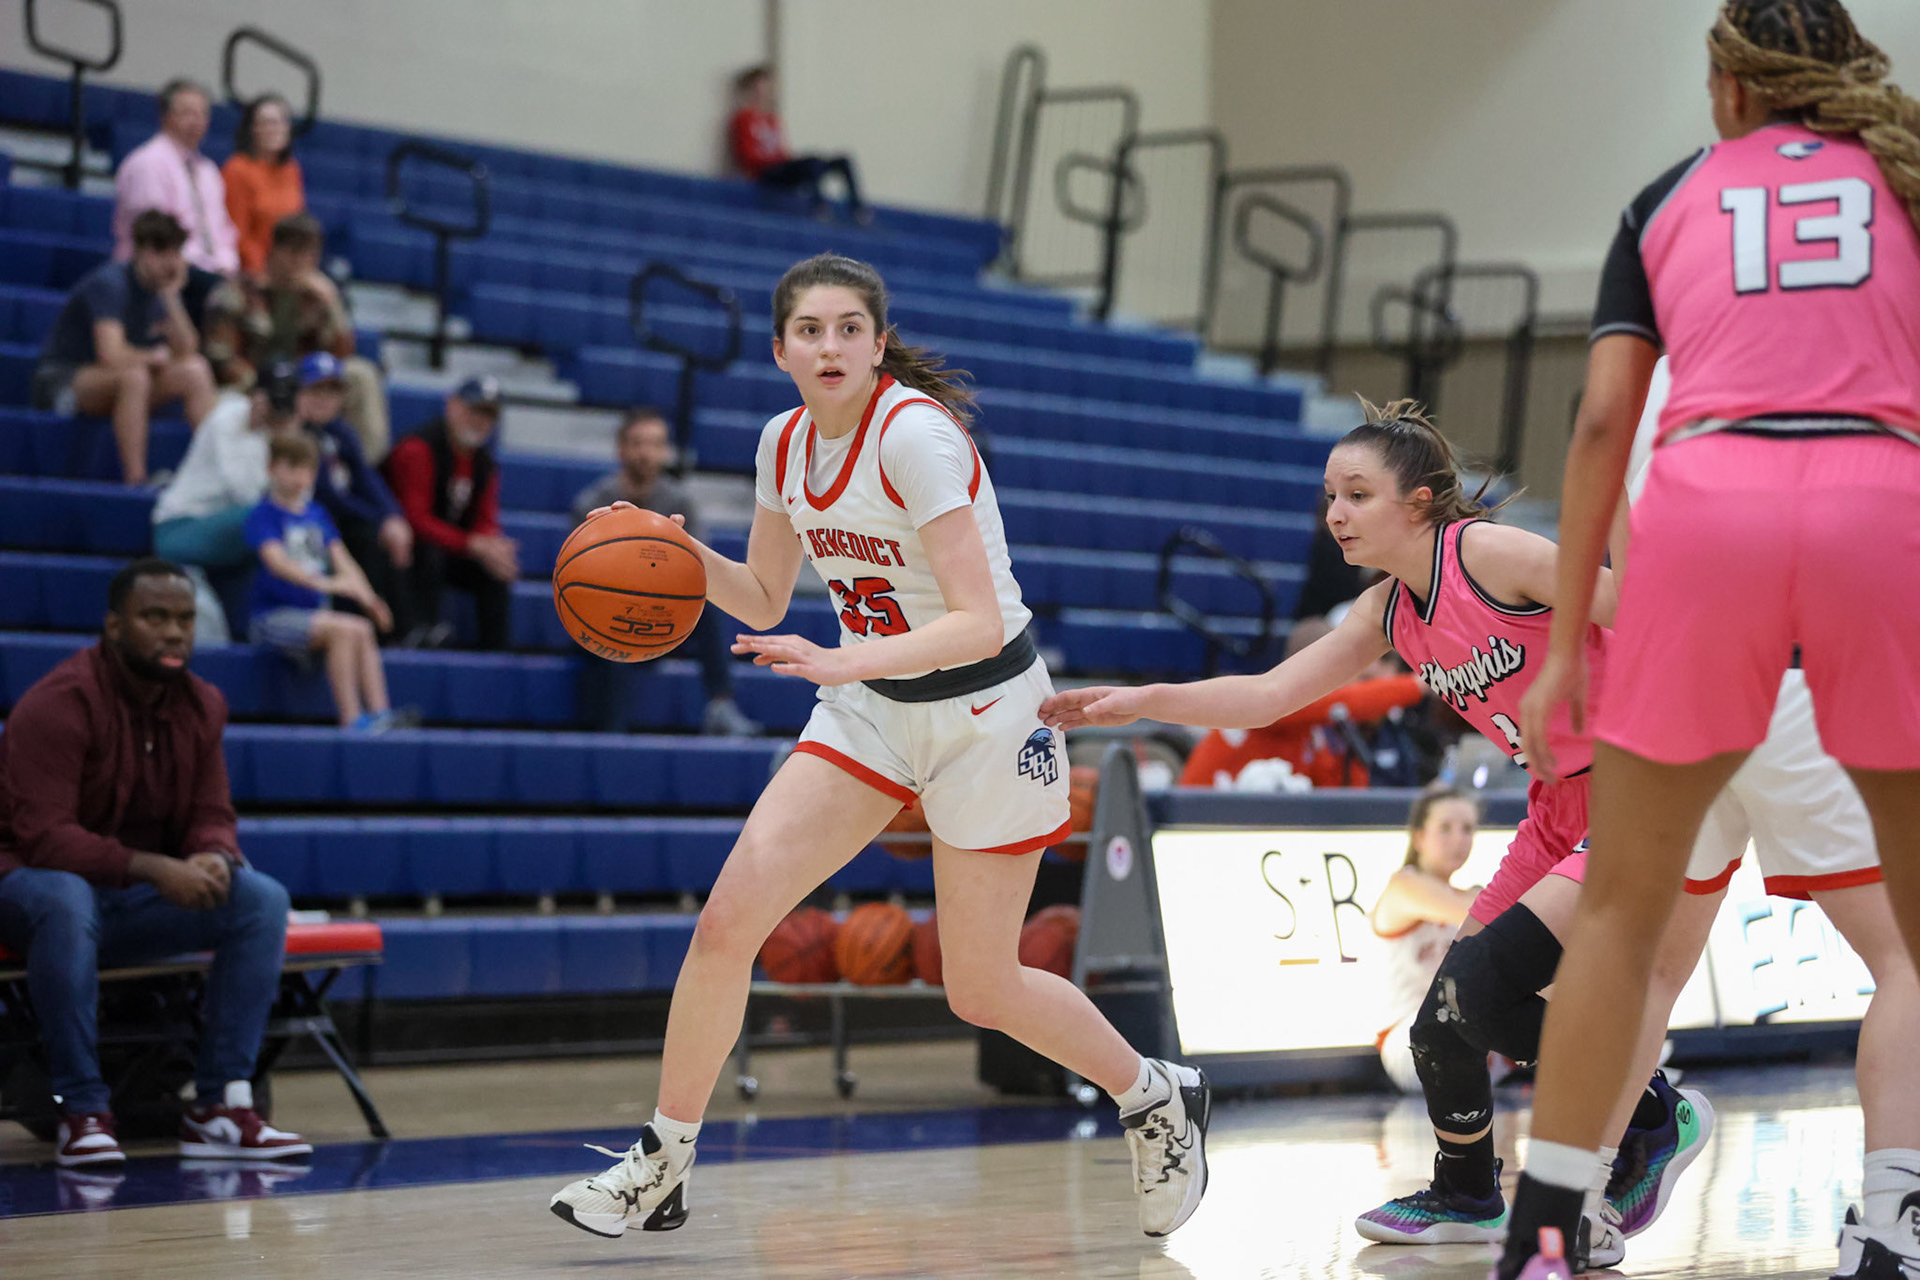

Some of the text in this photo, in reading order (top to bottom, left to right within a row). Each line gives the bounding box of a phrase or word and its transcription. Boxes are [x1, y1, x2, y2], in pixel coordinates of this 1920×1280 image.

[1720, 178, 1875, 295] 13
[806, 528, 905, 567] BENEDICT
[1420, 635, 1525, 711] Memphis
[1018, 746, 1058, 786] SBA
